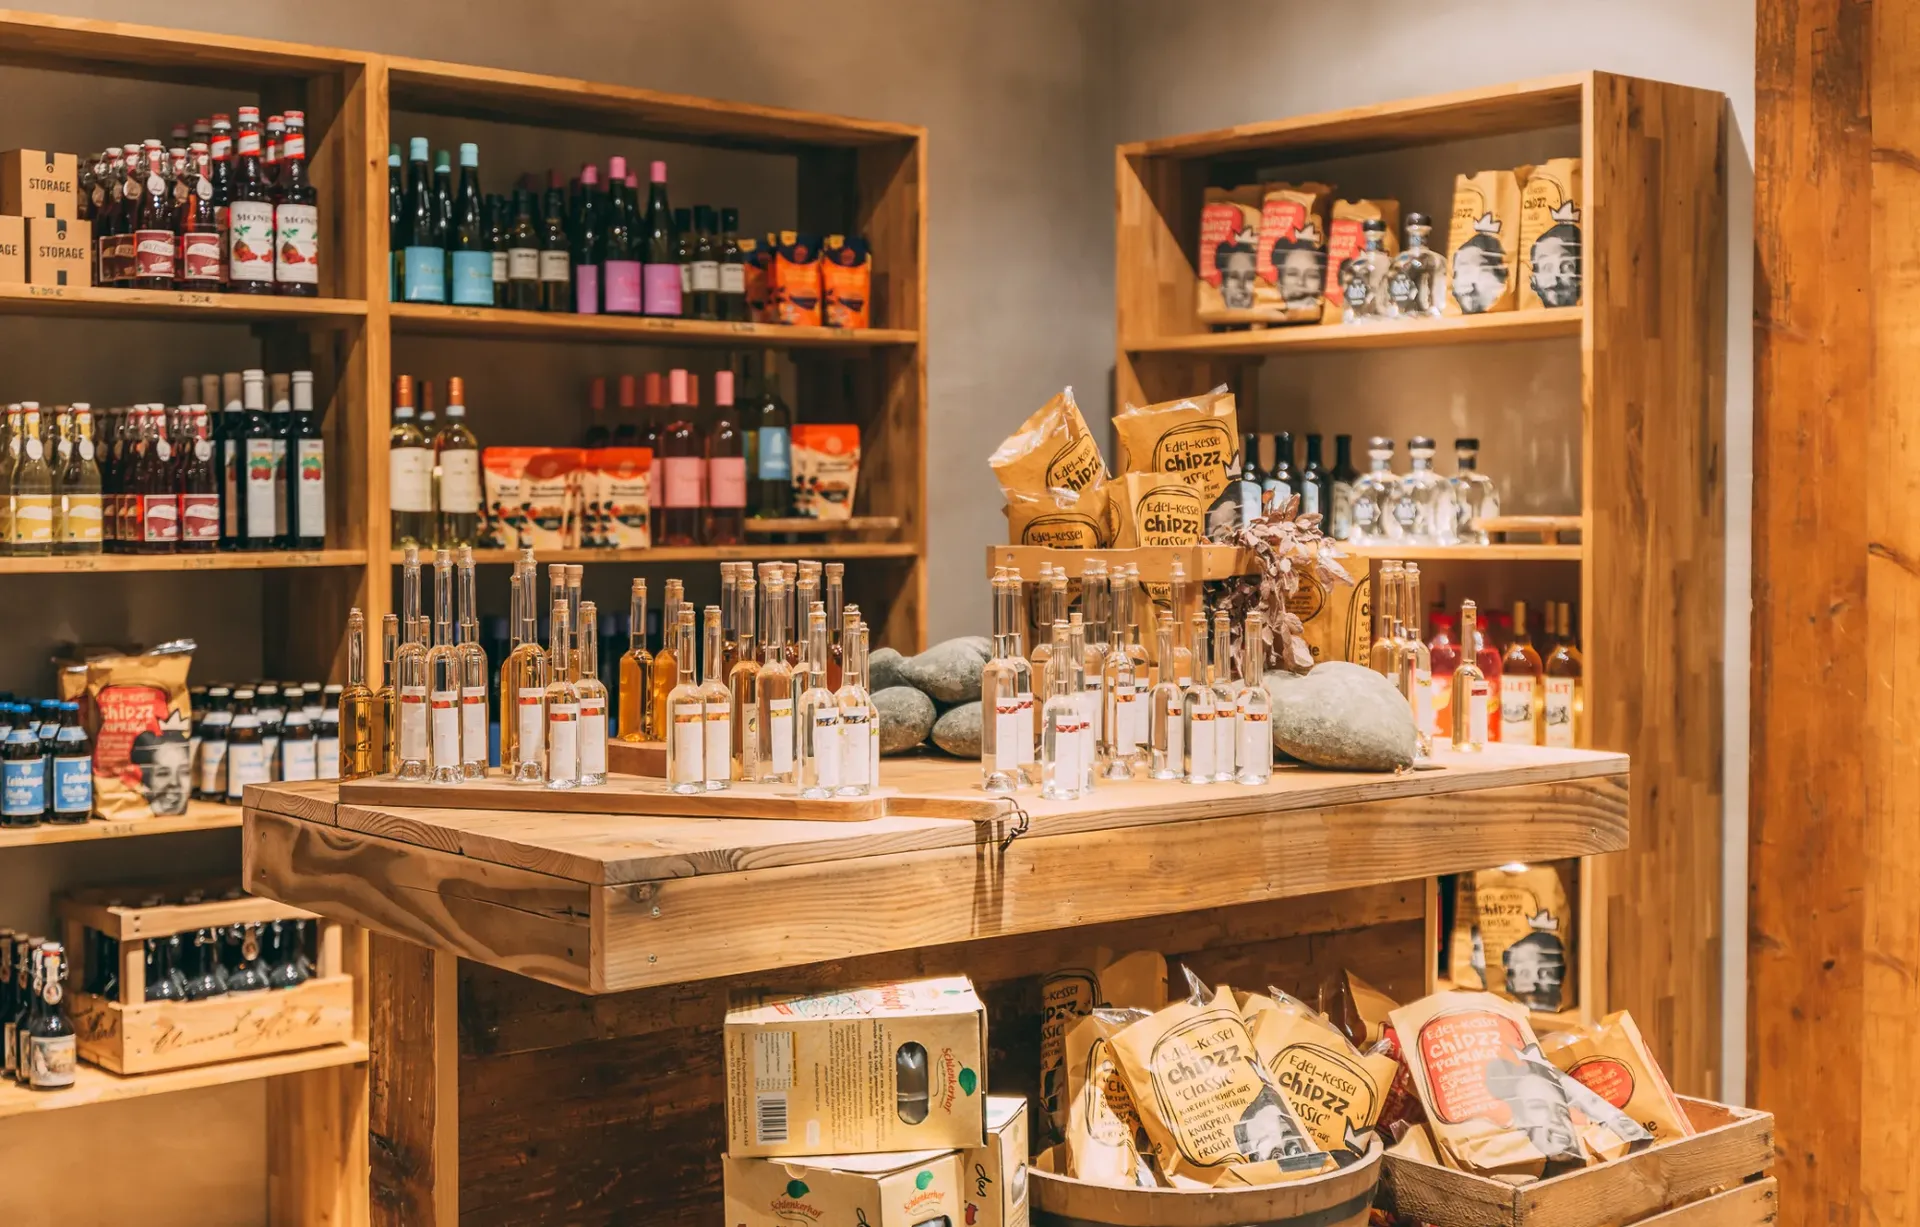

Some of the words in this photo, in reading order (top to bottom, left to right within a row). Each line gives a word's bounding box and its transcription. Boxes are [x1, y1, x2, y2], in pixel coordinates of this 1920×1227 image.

[29, 177, 72, 193] STORAGE
[39, 245, 85, 260] STORAGE
[1164, 450, 1221, 472] chipzz
[1031, 529, 1083, 542] Edel-Kessel
[1144, 514, 1198, 535] chipzz
[1162, 1027, 1235, 1063] Edel-Kessel
[1429, 1030, 1503, 1060] chipzz
[1167, 1044, 1242, 1085] chipzz
[1289, 1054, 1357, 1097] Edel-Kessel
[942, 1046, 957, 1115] Schlenkerhof
[1278, 1071, 1350, 1117] chipzz
[975, 1163, 993, 1197] das
[771, 1200, 824, 1218] Schlenkerhof
[904, 1190, 946, 1214] Schlenkerhof
